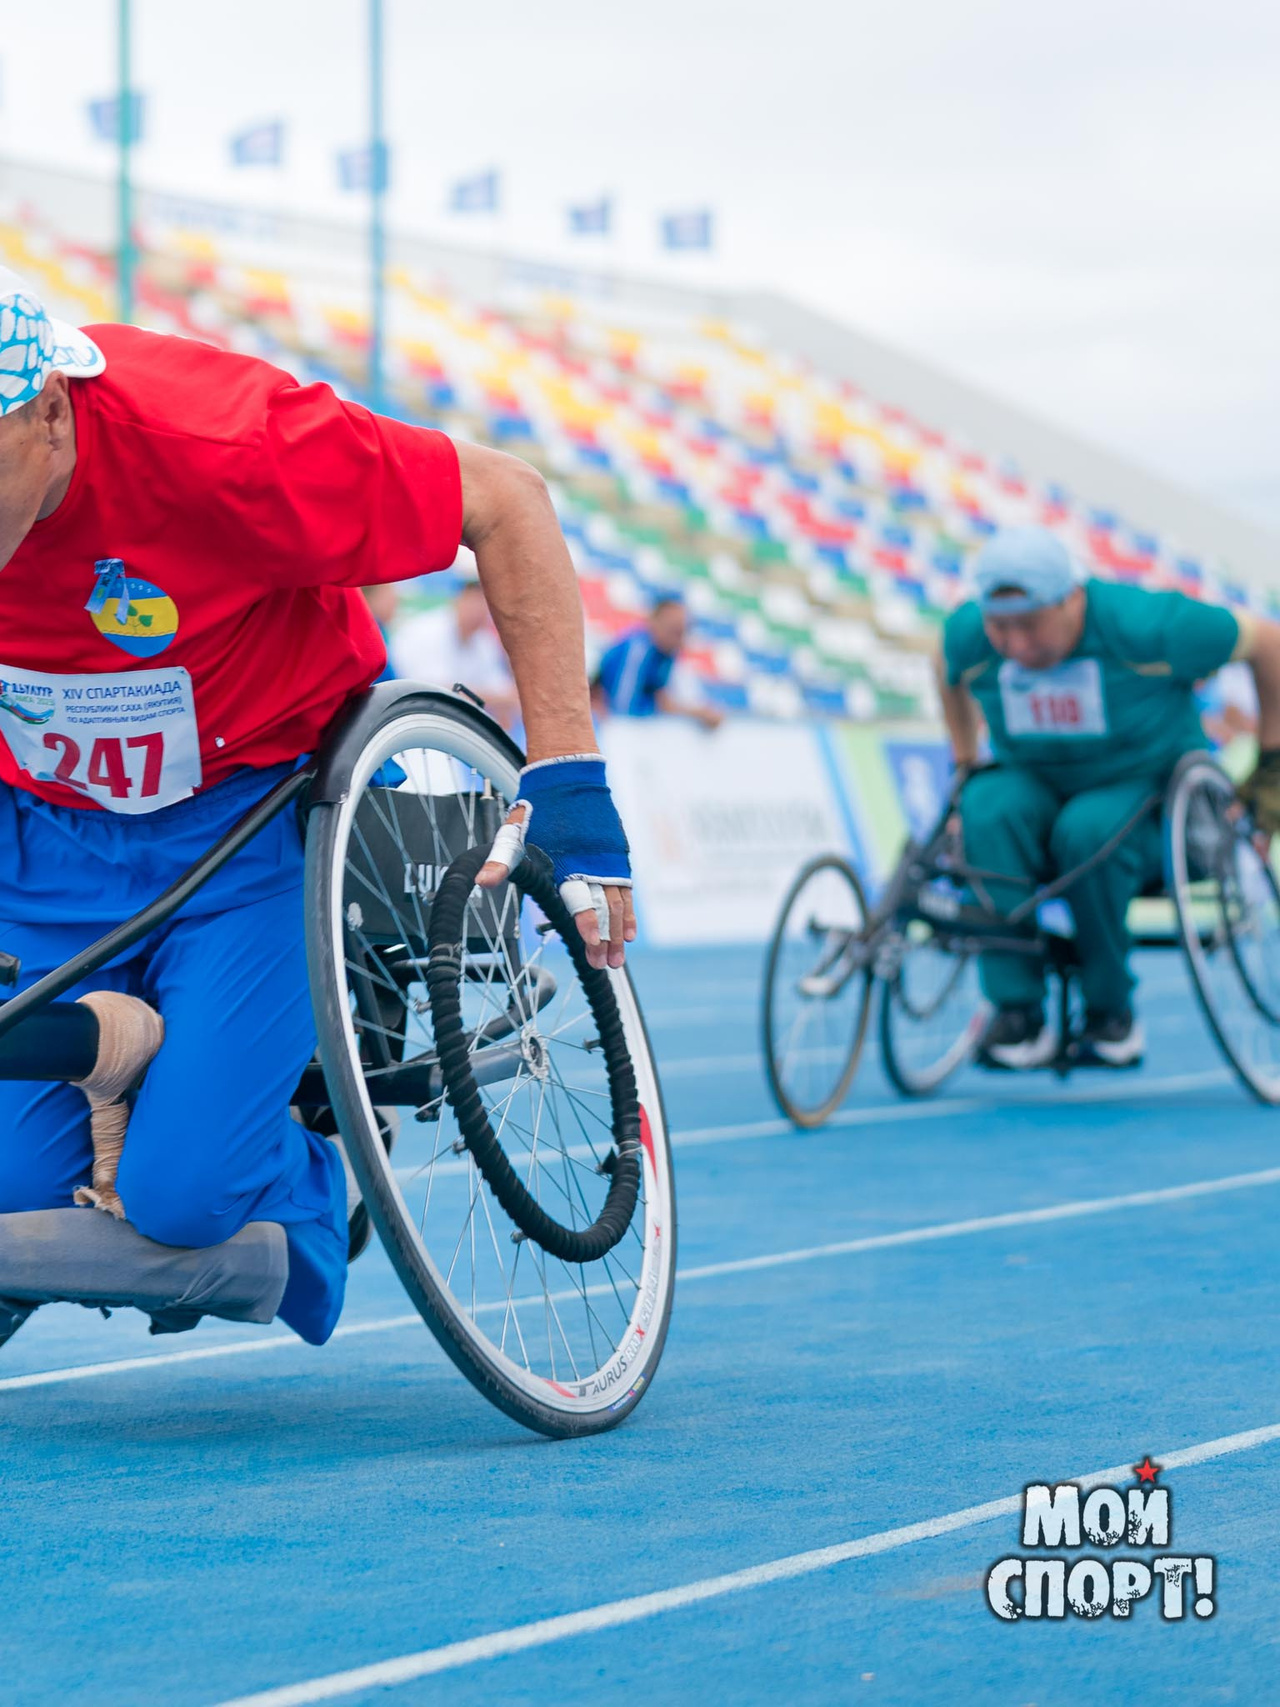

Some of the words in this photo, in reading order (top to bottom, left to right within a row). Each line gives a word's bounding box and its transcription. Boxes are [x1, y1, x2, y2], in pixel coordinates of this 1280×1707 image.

[61, 688, 83, 699] XIV
[86, 680, 182, 699] СПАРТАКИАДА
[65, 704, 119, 714] РЕСПУБЛИКИ
[120, 703, 141, 713] САХА
[144, 696, 182, 710] (ЯКУТИЯ)
[67, 716, 78, 724] ПО
[79, 715, 129, 725] АДАПТИВНЫМ
[130, 711, 157, 723] ВИДАМ
[157, 706, 186, 718] СПОРТА
[43, 731, 164, 798] 247
[569, 1354, 629, 1398] TAURUS
